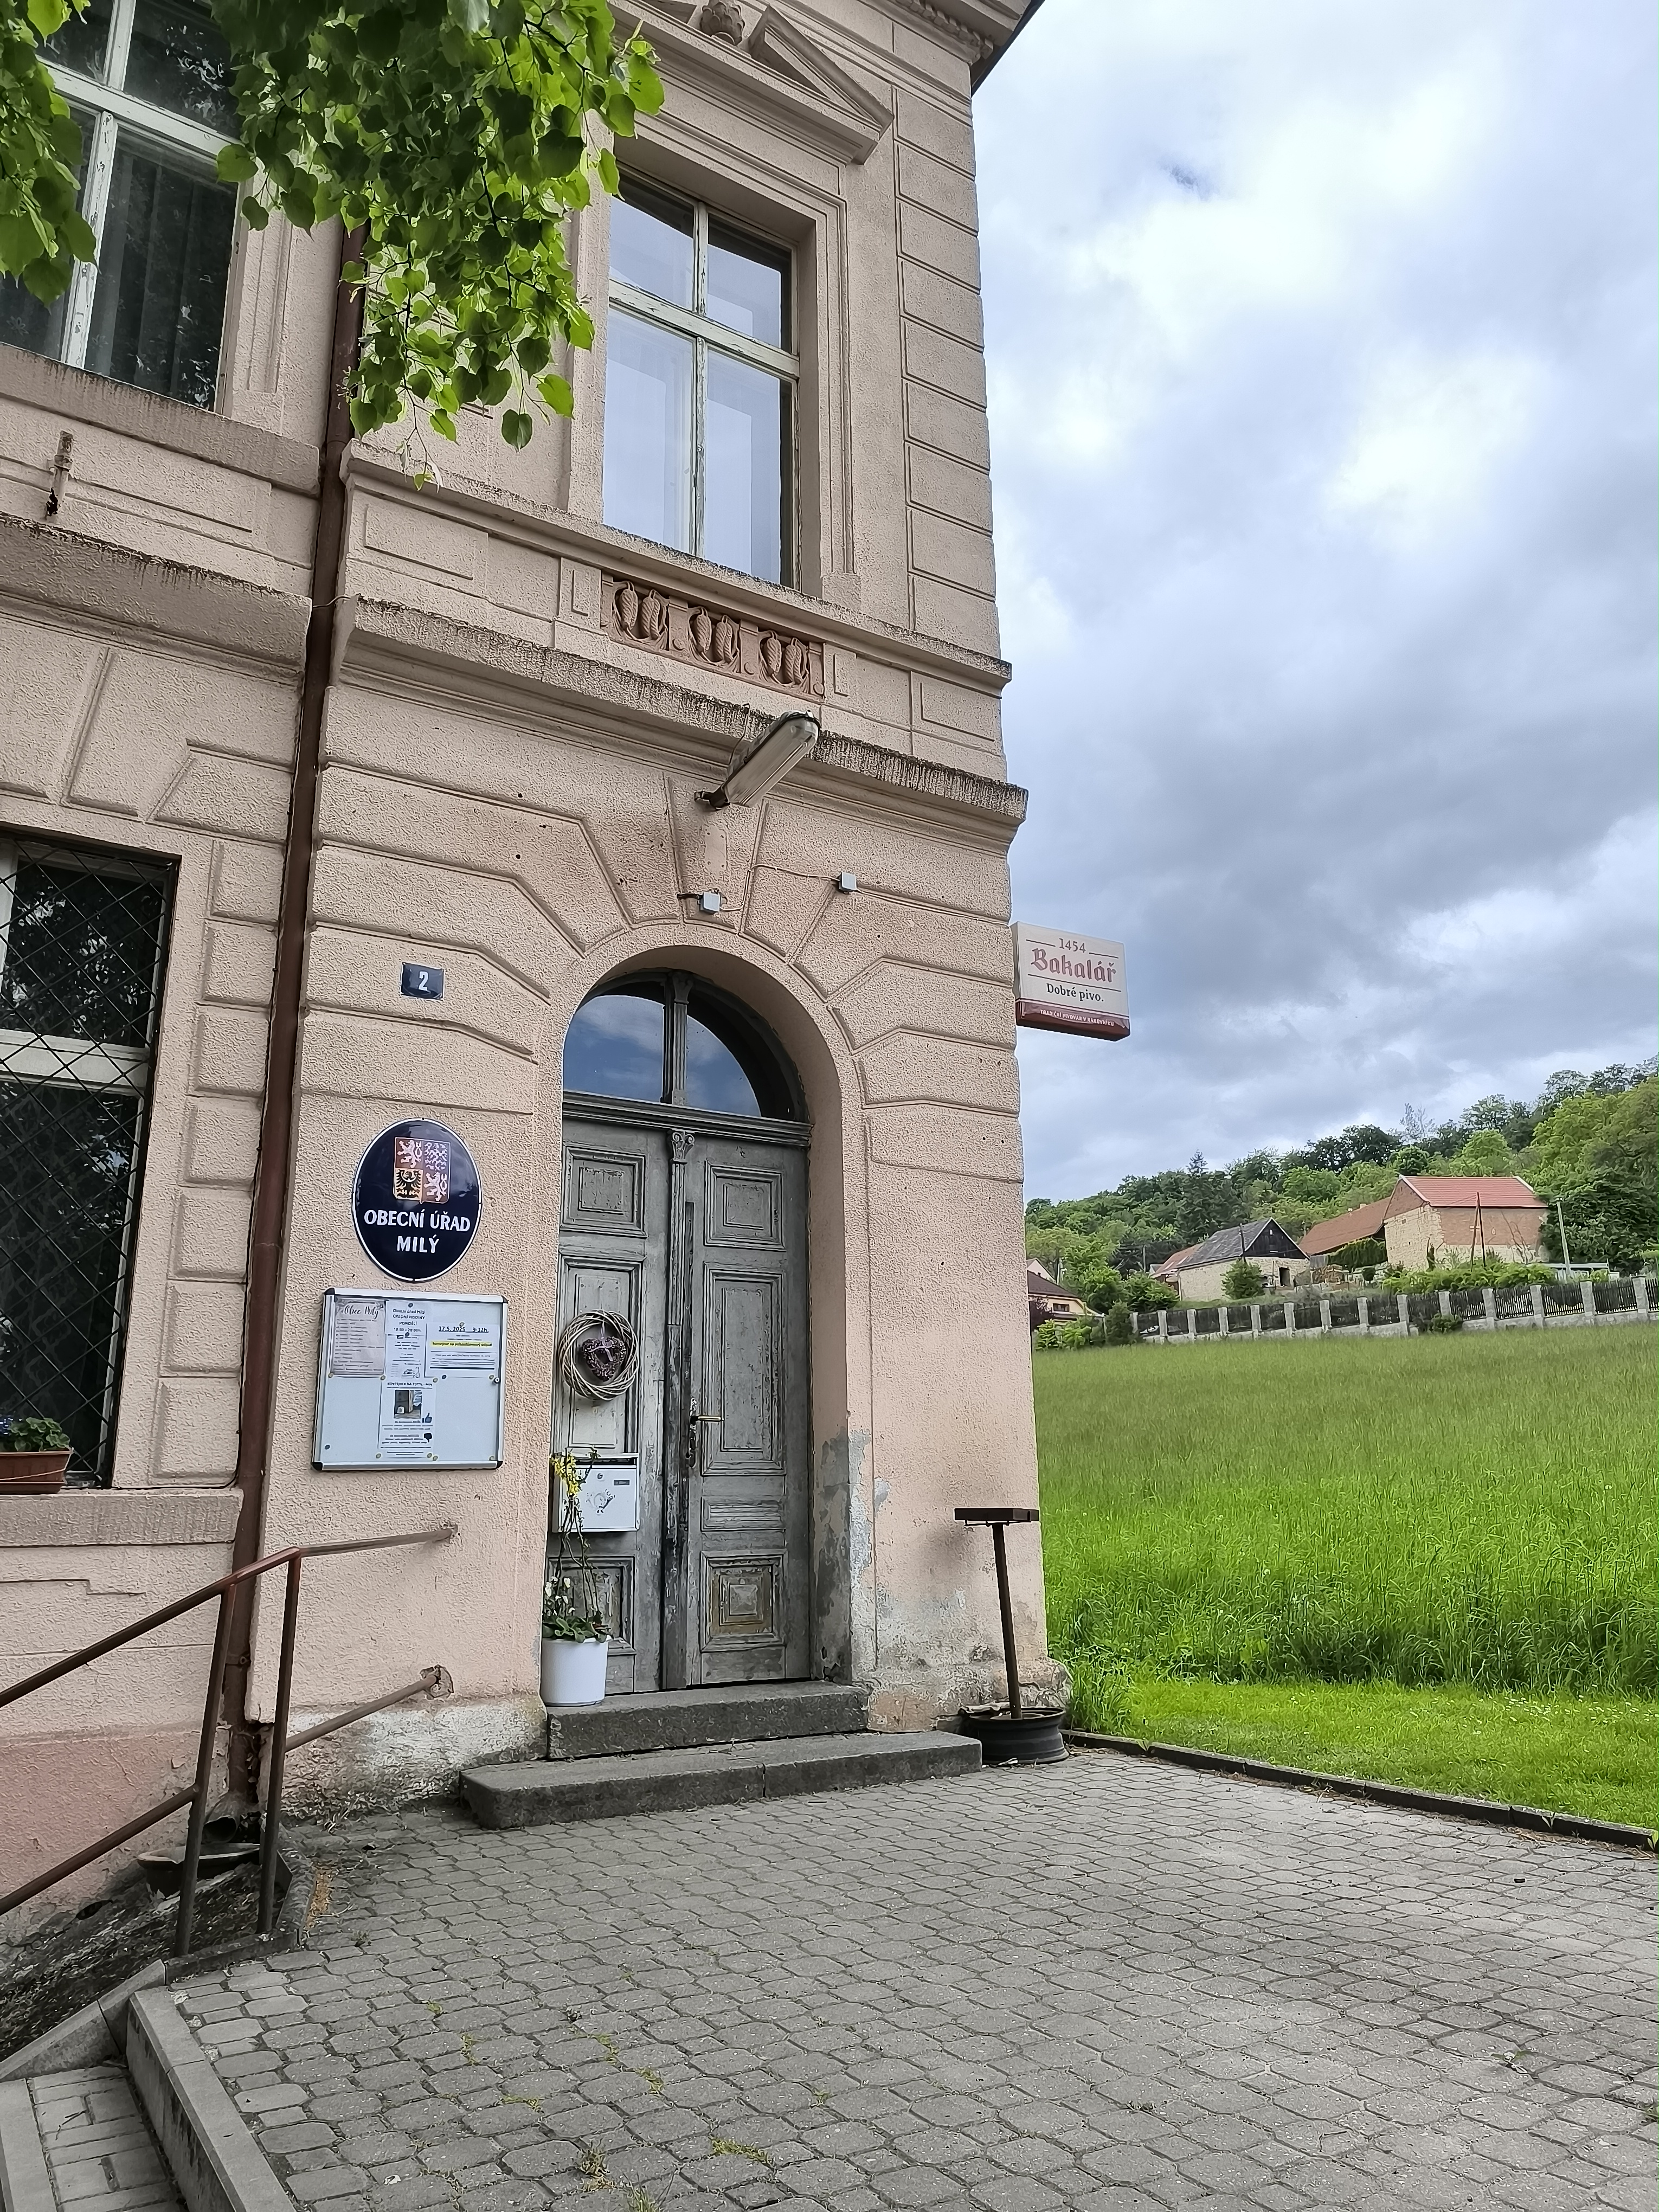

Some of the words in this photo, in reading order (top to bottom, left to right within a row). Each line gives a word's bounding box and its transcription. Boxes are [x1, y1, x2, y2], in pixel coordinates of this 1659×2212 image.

[1059, 938, 1086, 953] 1454
[1031, 948, 1117, 983] Bakalář
[418, 971, 428, 991] 2
[1046, 983, 1076, 998] Dobré
[1079, 989, 1104, 1002] pivo.
[1040, 1009, 1062, 1018] TRADIČNÍ
[364, 1209, 425, 1228] OBECNÍ
[430, 1210, 471, 1232] ÚŘAD
[397, 1234, 440, 1253] MILÝ
